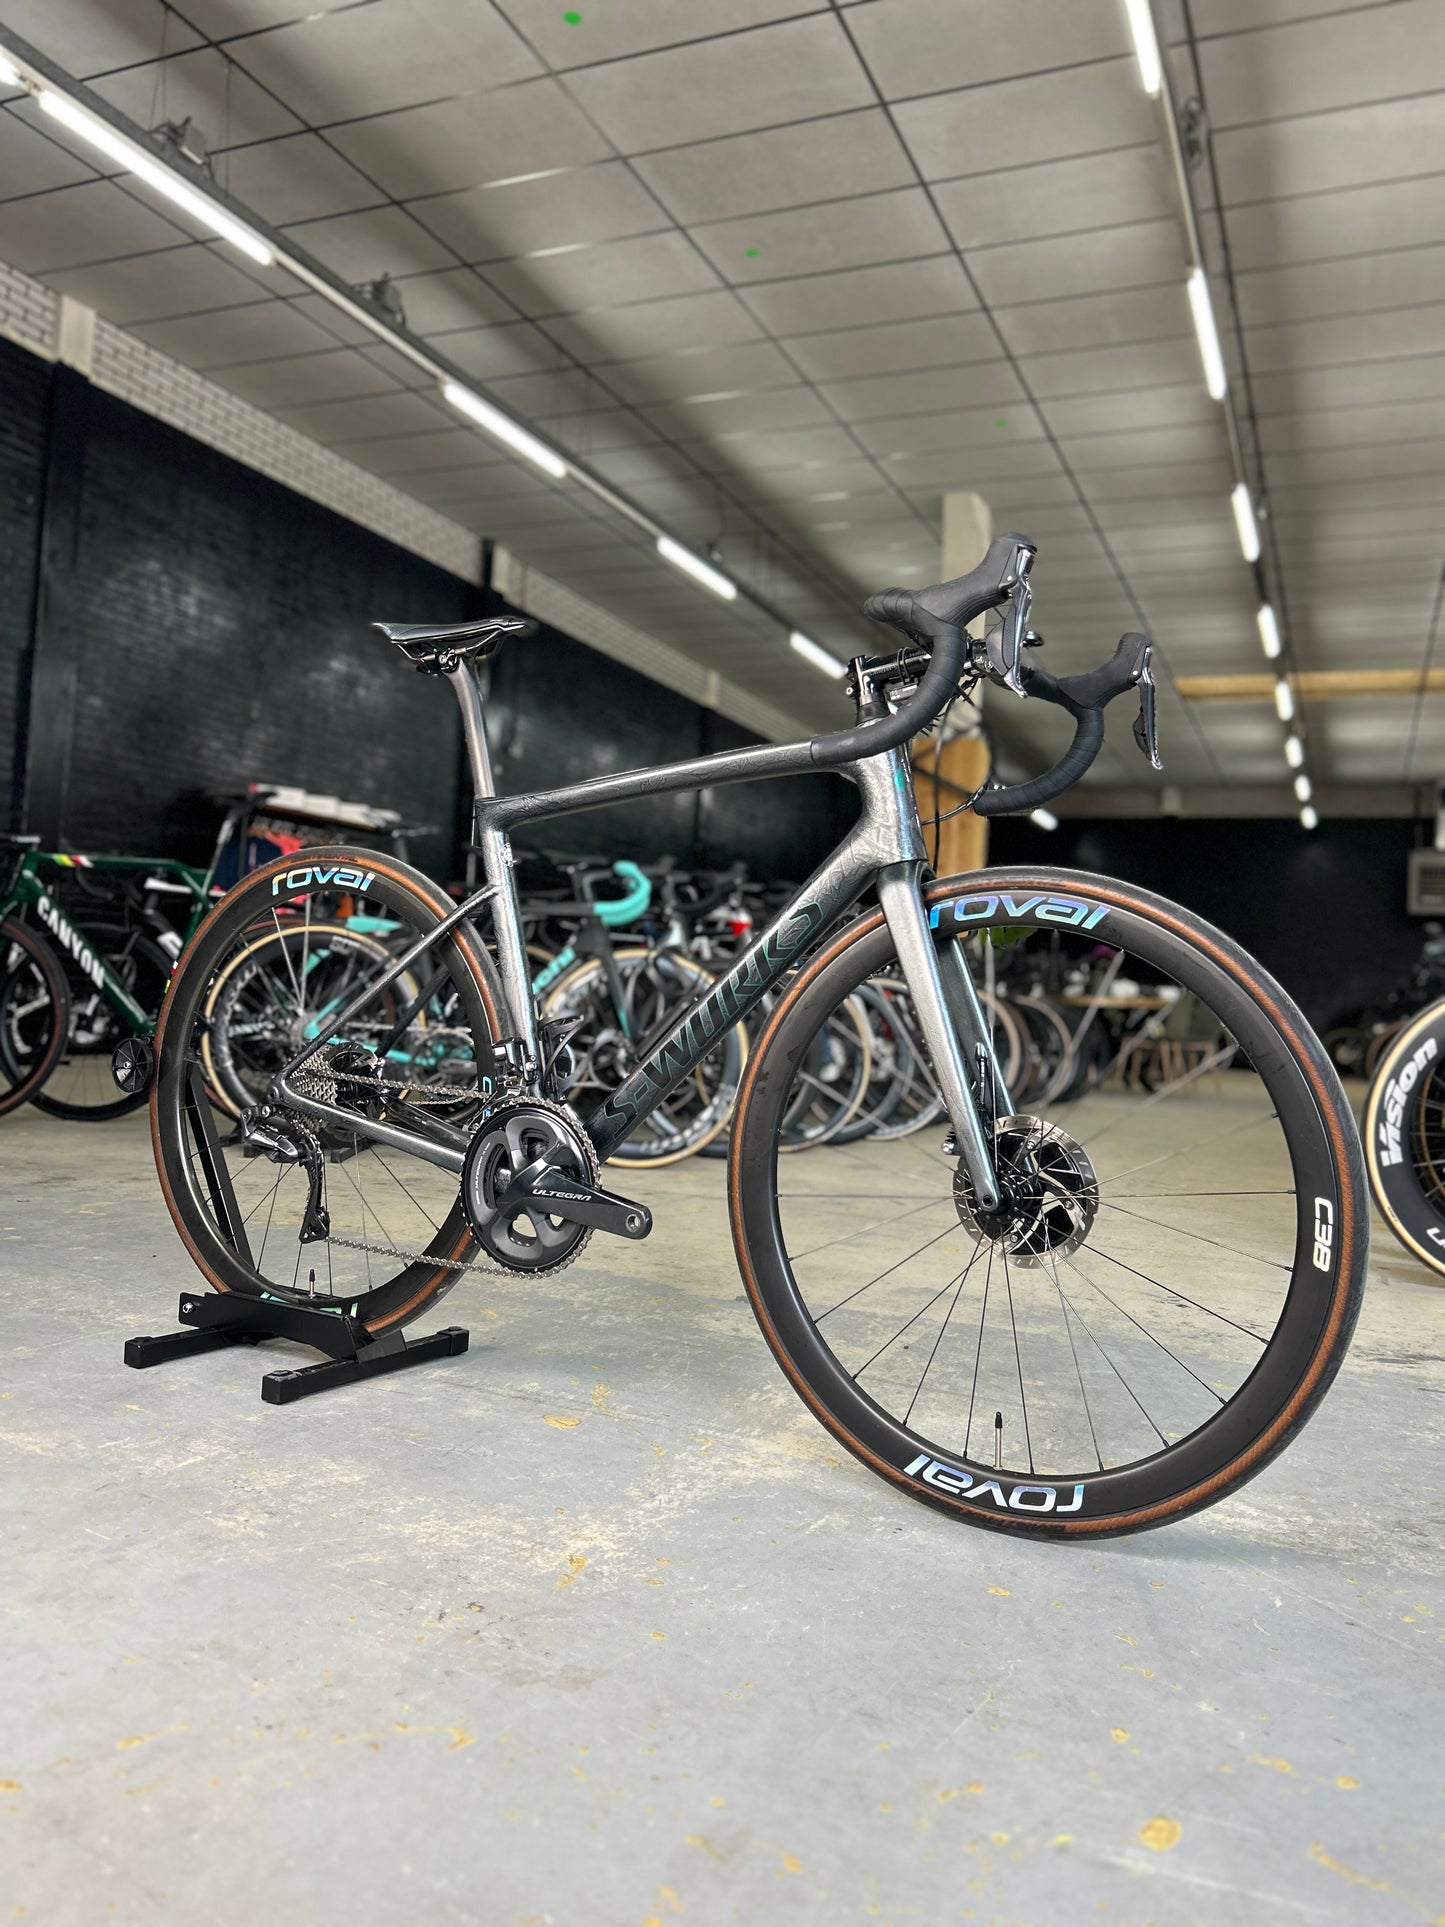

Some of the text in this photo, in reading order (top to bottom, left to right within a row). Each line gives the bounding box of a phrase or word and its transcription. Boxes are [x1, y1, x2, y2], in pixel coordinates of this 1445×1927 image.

[272, 866, 376, 896] roval
[38, 895, 104, 989] CANYON
[930, 895, 1111, 930] roval
[604, 902, 824, 1141] S-WORKS
[532, 1188, 592, 1201] ULTEGRA
[1313, 1197, 1334, 1272] C38
[903, 1454, 1085, 1513] roval
